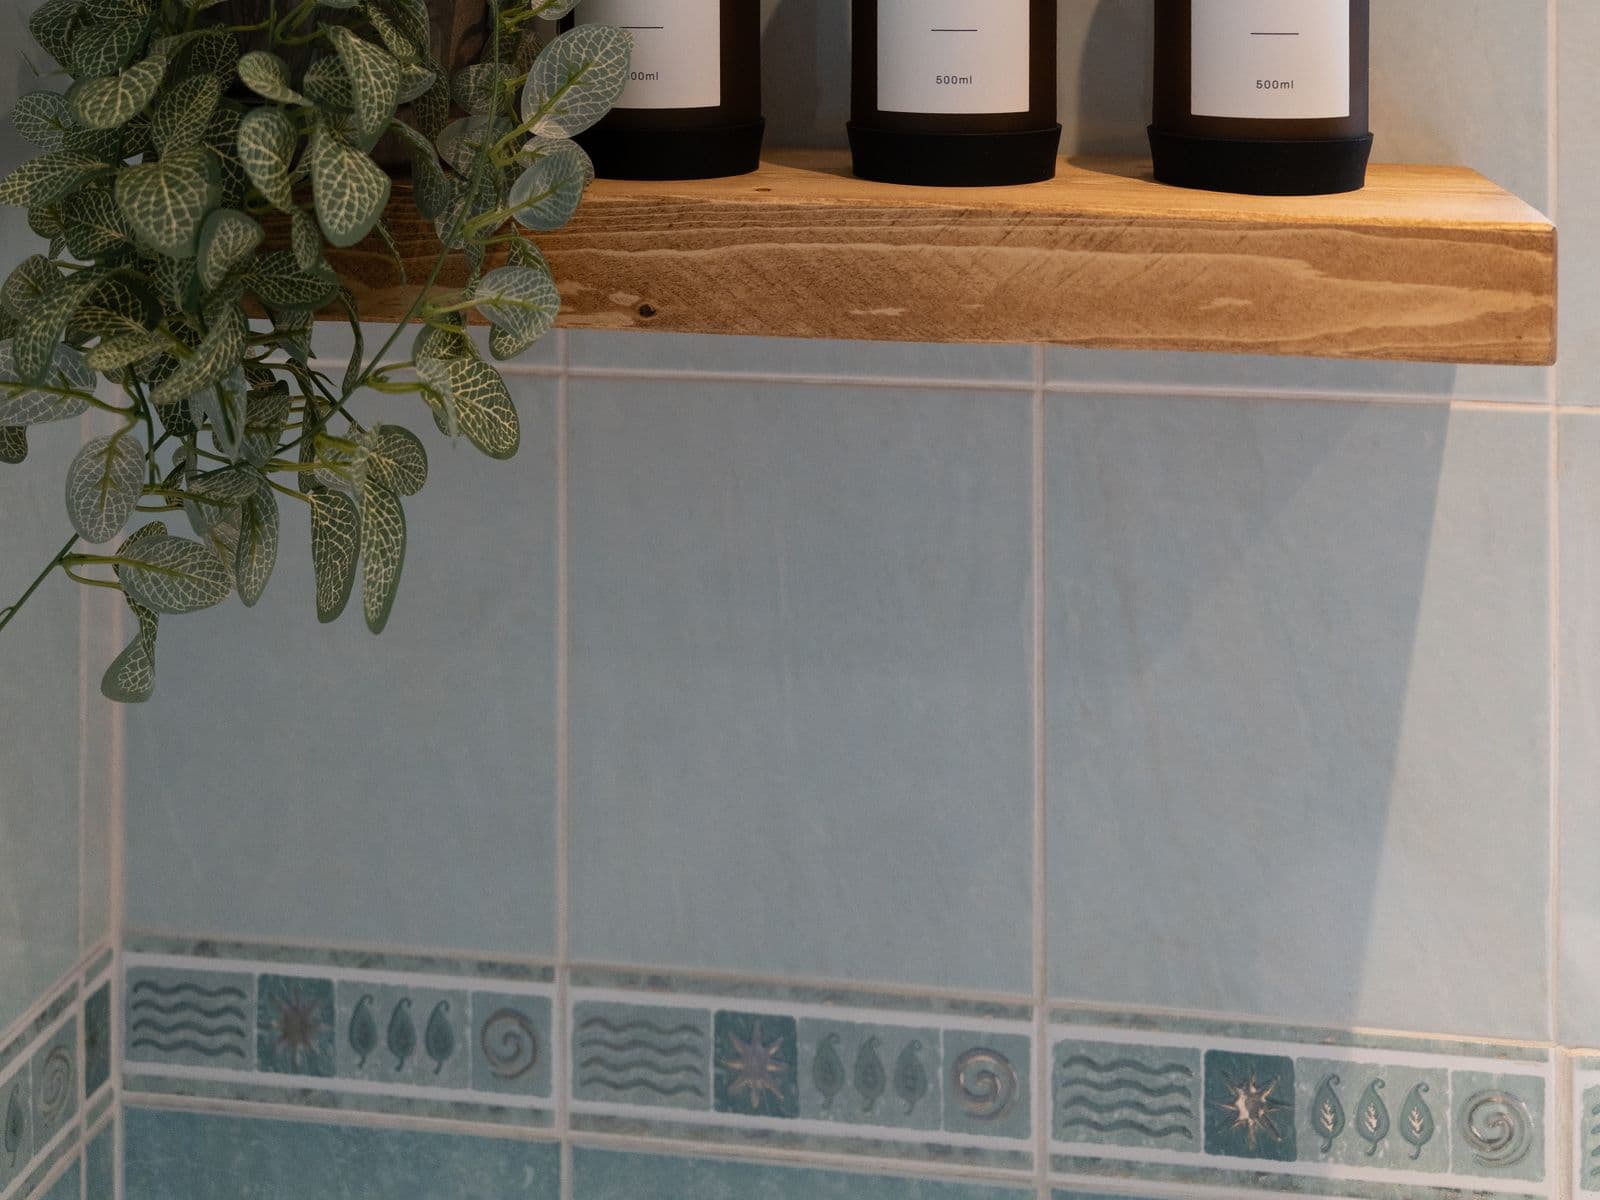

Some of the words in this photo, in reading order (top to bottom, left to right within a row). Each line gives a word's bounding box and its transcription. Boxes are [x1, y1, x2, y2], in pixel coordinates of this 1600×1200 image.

[627, 71, 659, 81] 00ml
[935, 75, 973, 85] 500ml
[1256, 79, 1294, 89] 500ml
